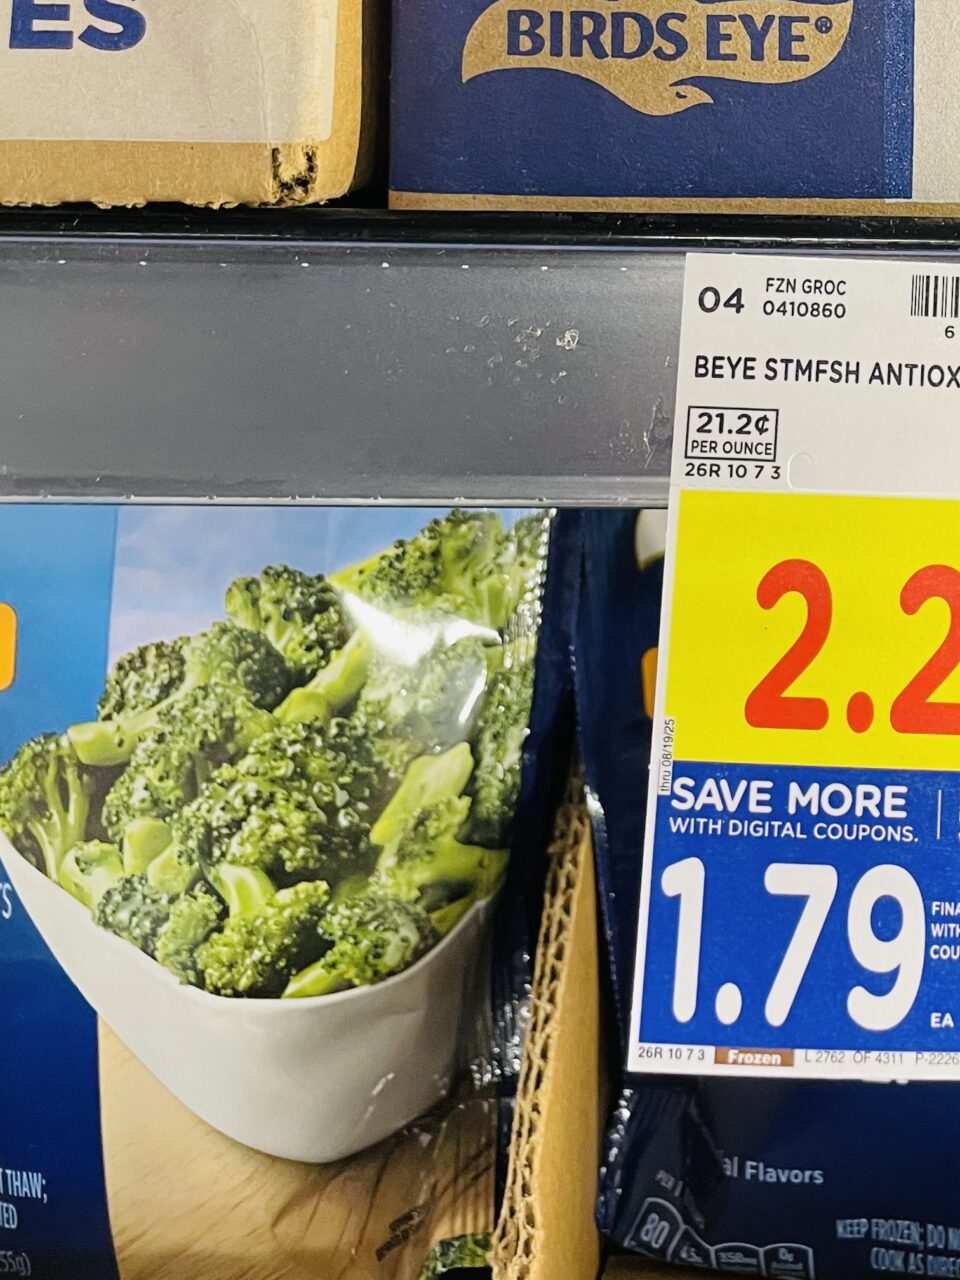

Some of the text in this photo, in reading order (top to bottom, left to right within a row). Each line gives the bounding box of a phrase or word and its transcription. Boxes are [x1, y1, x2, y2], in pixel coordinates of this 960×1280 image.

[506, 8, 689, 62] BIRDS
[765, 277, 847, 296] FZN GROC
[698, 286, 745, 314] 04
[762, 300, 847, 319] 0410860
[944, 325, 955, 339] 6
[694, 355, 757, 380] BEYE
[764, 358, 861, 384] STMFSH
[868, 361, 960, 388] ANTIOX
[696, 412, 770, 435] 21.2¢
[691, 440, 773, 456] PER OUNCE
[685, 463, 781, 480] 26R 10 7 3
[671, 777, 908, 818] SAVE MORE
[669, 816, 919, 842] WITH DIGITAL COUPONS.
[661, 856, 926, 1032] 1.79
[930, 1013, 954, 1028] EA
[638, 1047, 705, 1061] 26R 10 7 3
[727, 1048, 782, 1065] Frozen
[815, 1051, 846, 1064] 2762
[852, 1050, 871, 1064] OF
[874, 1052, 904, 1066] 4311
[744, 1160, 825, 1184] Flavors
[640, 1212, 670, 1249] 80
[836, 1218, 869, 1238] KEEP
[907, 1252, 925, 1274] AS
